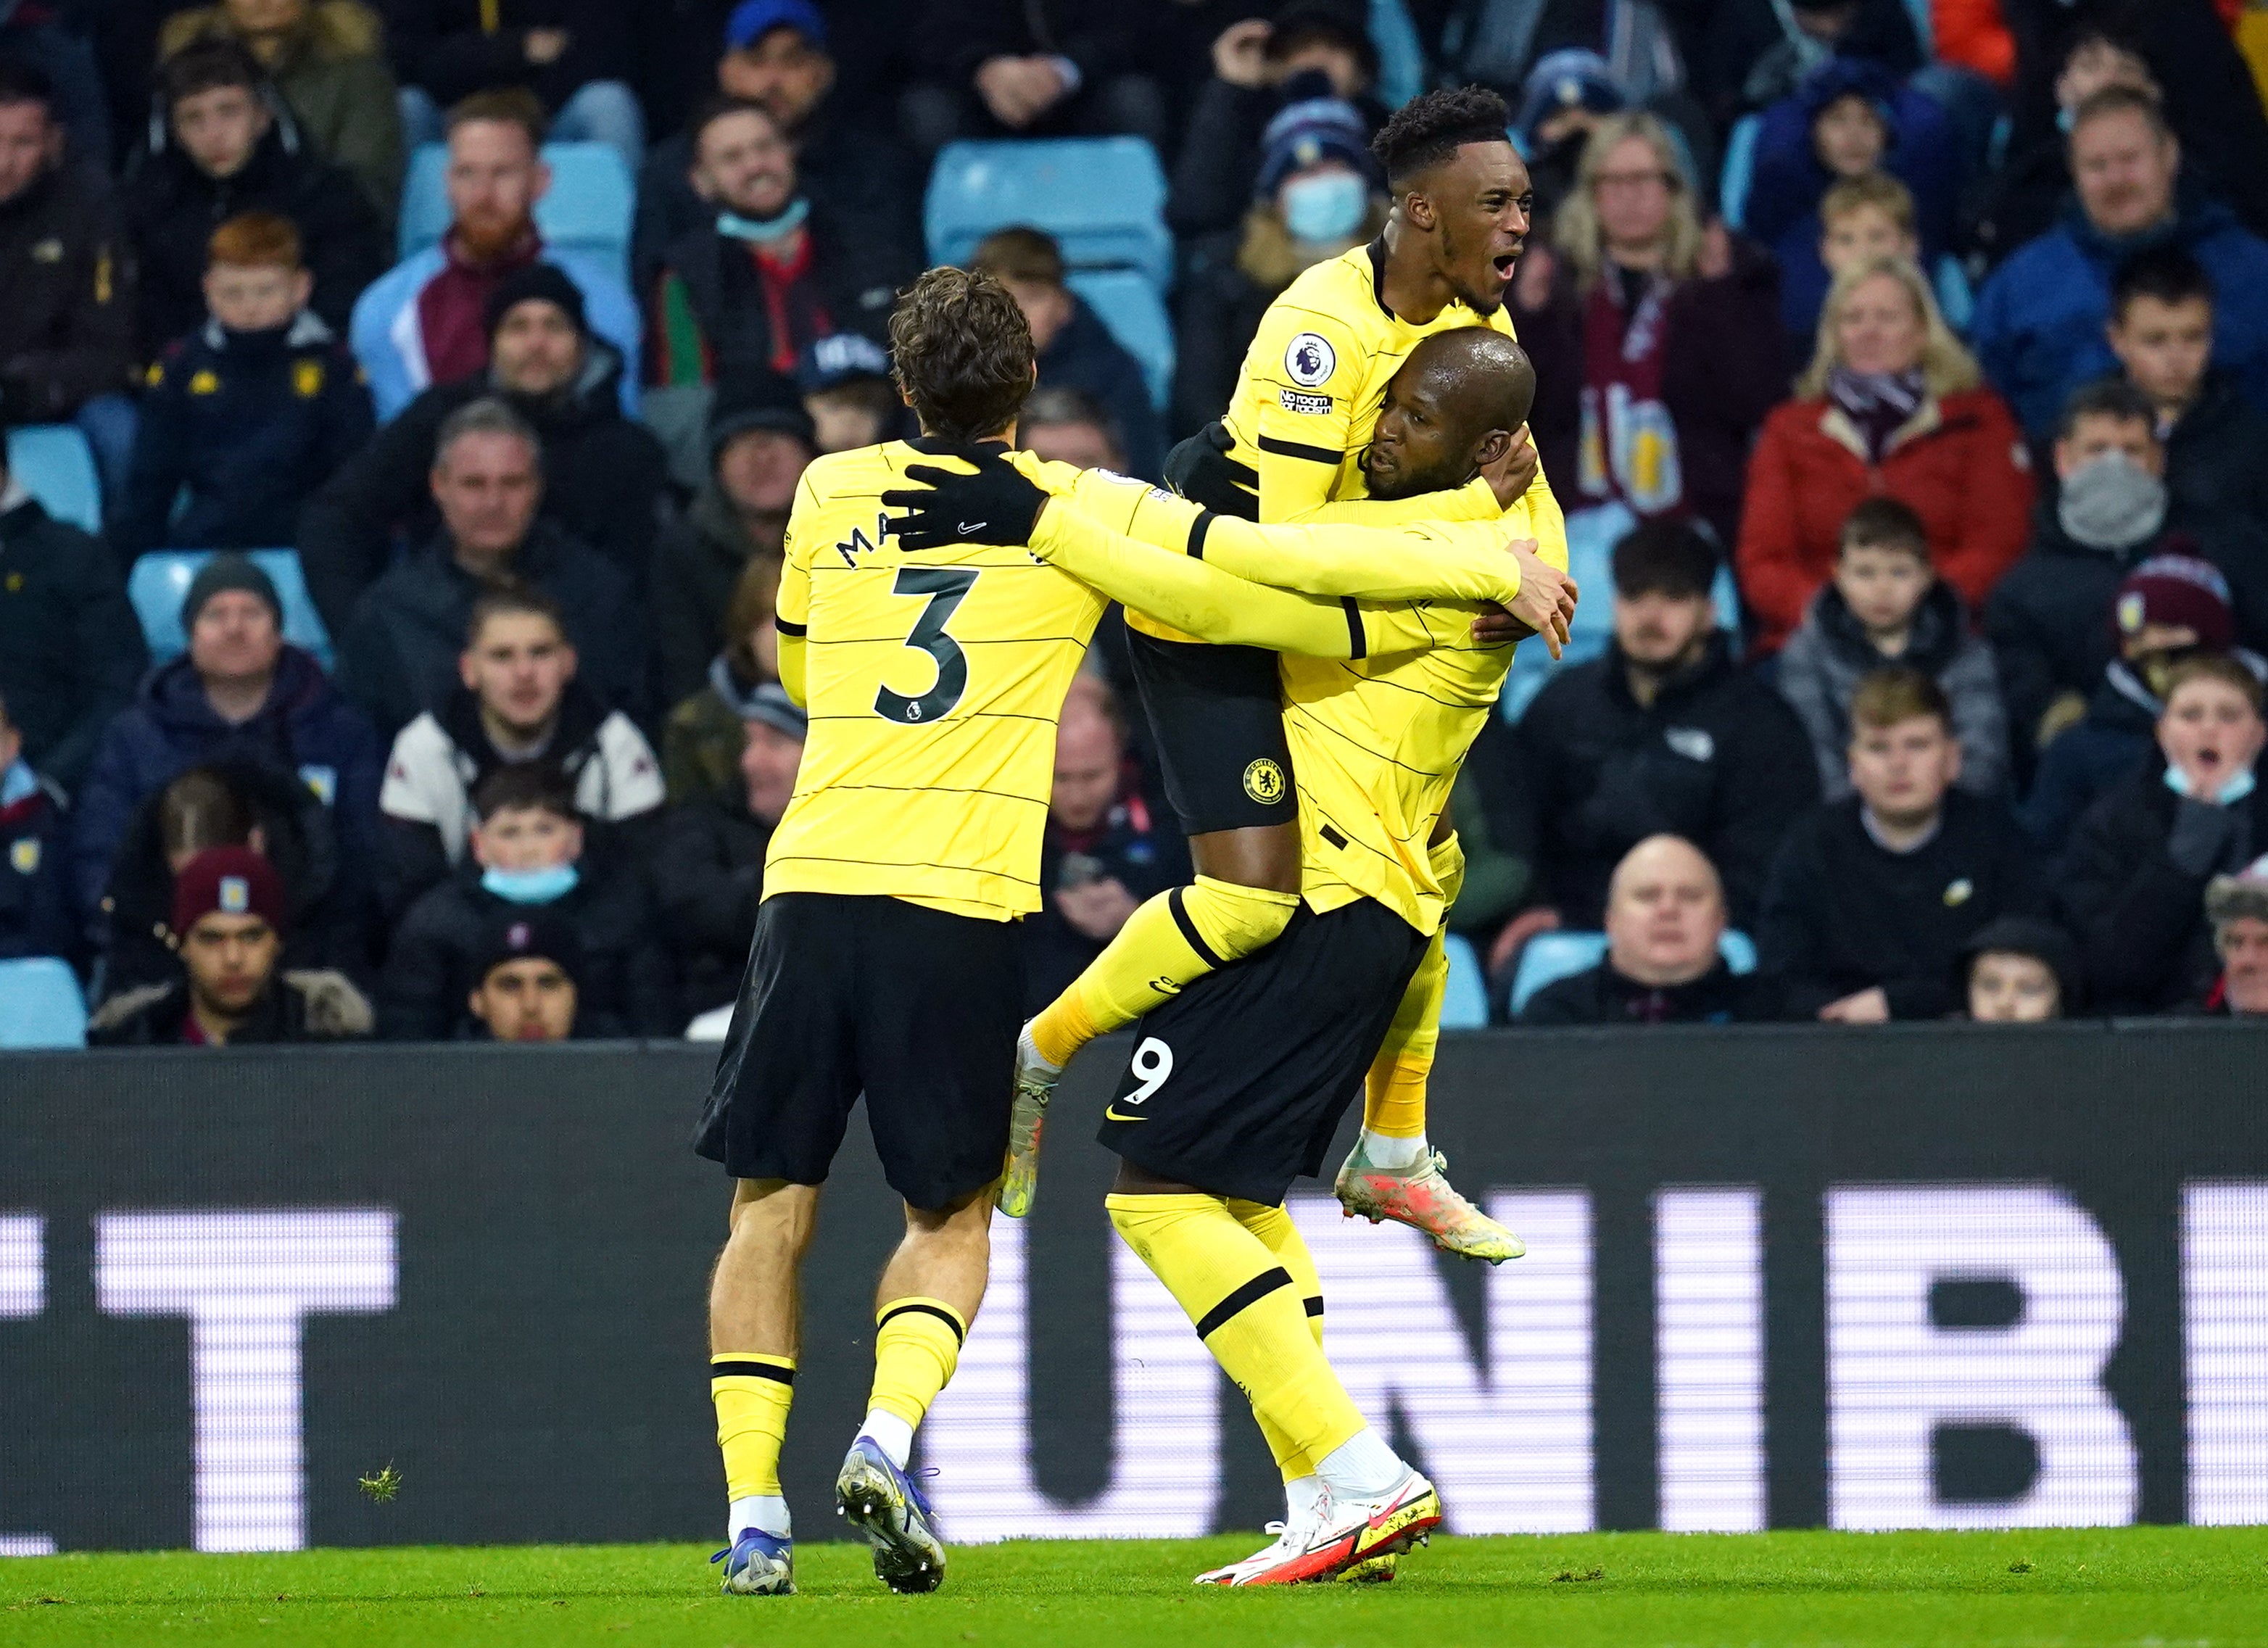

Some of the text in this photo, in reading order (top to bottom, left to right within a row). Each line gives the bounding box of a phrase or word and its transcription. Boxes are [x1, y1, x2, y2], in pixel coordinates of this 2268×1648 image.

[1280, 389, 1328, 407] No room
[1296, 404, 1332, 414] racism
[874, 568, 980, 724] 3
[1123, 1036, 1173, 1105] 9
